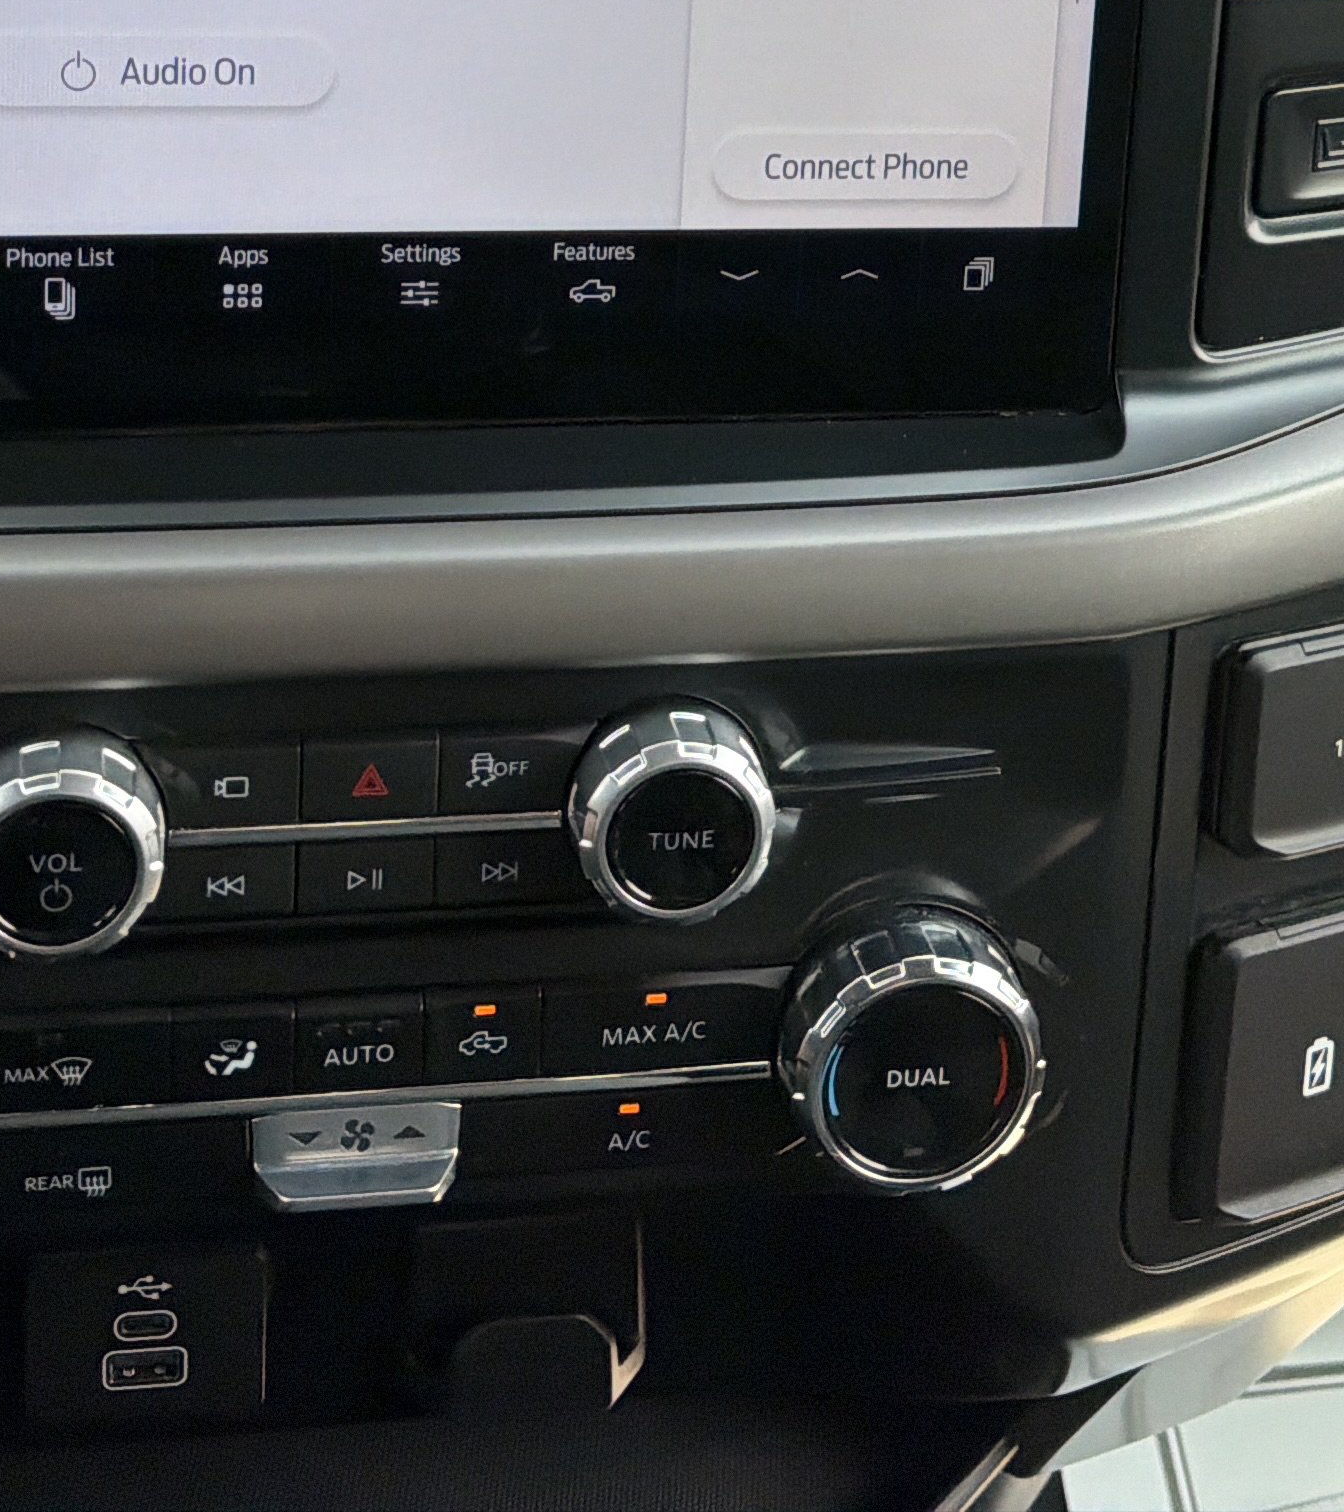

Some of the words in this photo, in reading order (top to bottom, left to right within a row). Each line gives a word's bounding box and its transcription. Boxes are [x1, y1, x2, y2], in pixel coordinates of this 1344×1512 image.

[120, 55, 207, 87] Audio
[213, 58, 256, 87] On
[763, 152, 877, 181] Connect
[882, 152, 969, 181] Phone
[5, 246, 71, 269] Phone
[76, 246, 115, 268] List
[217, 244, 269, 271] Apps
[380, 242, 462, 268] Settings
[553, 241, 636, 264] Features
[494, 759, 530, 778] OFF
[648, 829, 716, 852] TUNE
[29, 852, 83, 874] VOL
[601, 1023, 657, 1049] MAX
[662, 1020, 708, 1043] A/C
[323, 1043, 395, 1068] AUTO
[4, 1065, 51, 1085] MAX
[886, 1066, 951, 1089] DUAL
[607, 1130, 651, 1152] A/C
[24, 1174, 75, 1193] REAR
